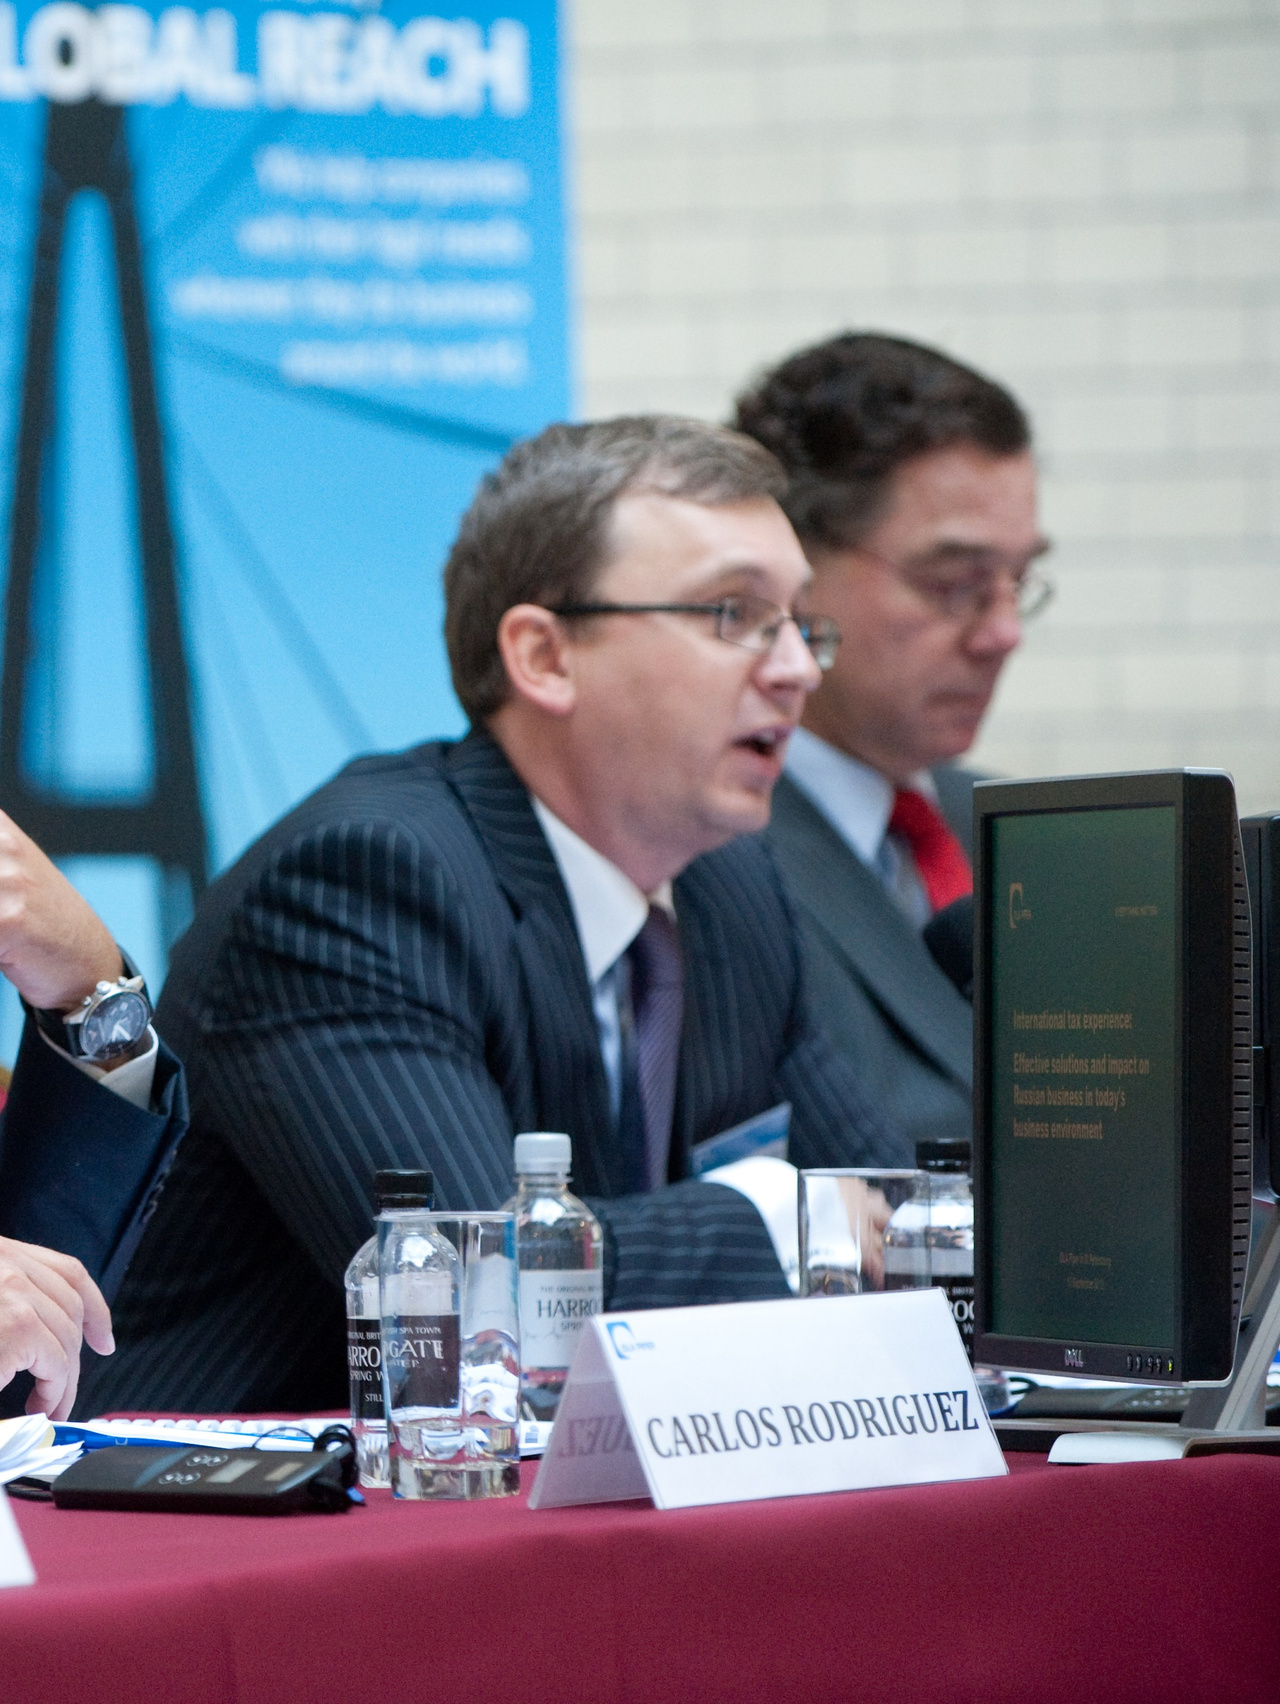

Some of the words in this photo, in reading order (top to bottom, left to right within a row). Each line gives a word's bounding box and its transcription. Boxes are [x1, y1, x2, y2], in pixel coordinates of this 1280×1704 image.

[259, 11, 531, 116] REACH
[1012, 1009, 1066, 1030] International
[1067, 1010, 1081, 1029] tax
[1012, 1052, 1049, 1074] Effective
[1051, 1053, 1089, 1074] solutions
[1090, 1053, 1106, 1074] and
[1107, 1053, 1137, 1080] impact
[1138, 1058, 1150, 1074] on
[1012, 1084, 1045, 1105] Russian
[1046, 1085, 1084, 1106] business
[1085, 1086, 1093, 1106] in
[1012, 1116, 1049, 1138] business
[1051, 1117, 1103, 1140] environment
[415, 1326, 441, 1334] TOWN
[647, 1407, 781, 1459] CARLOS
[782, 1390, 979, 1447] RODRIGUEZ
